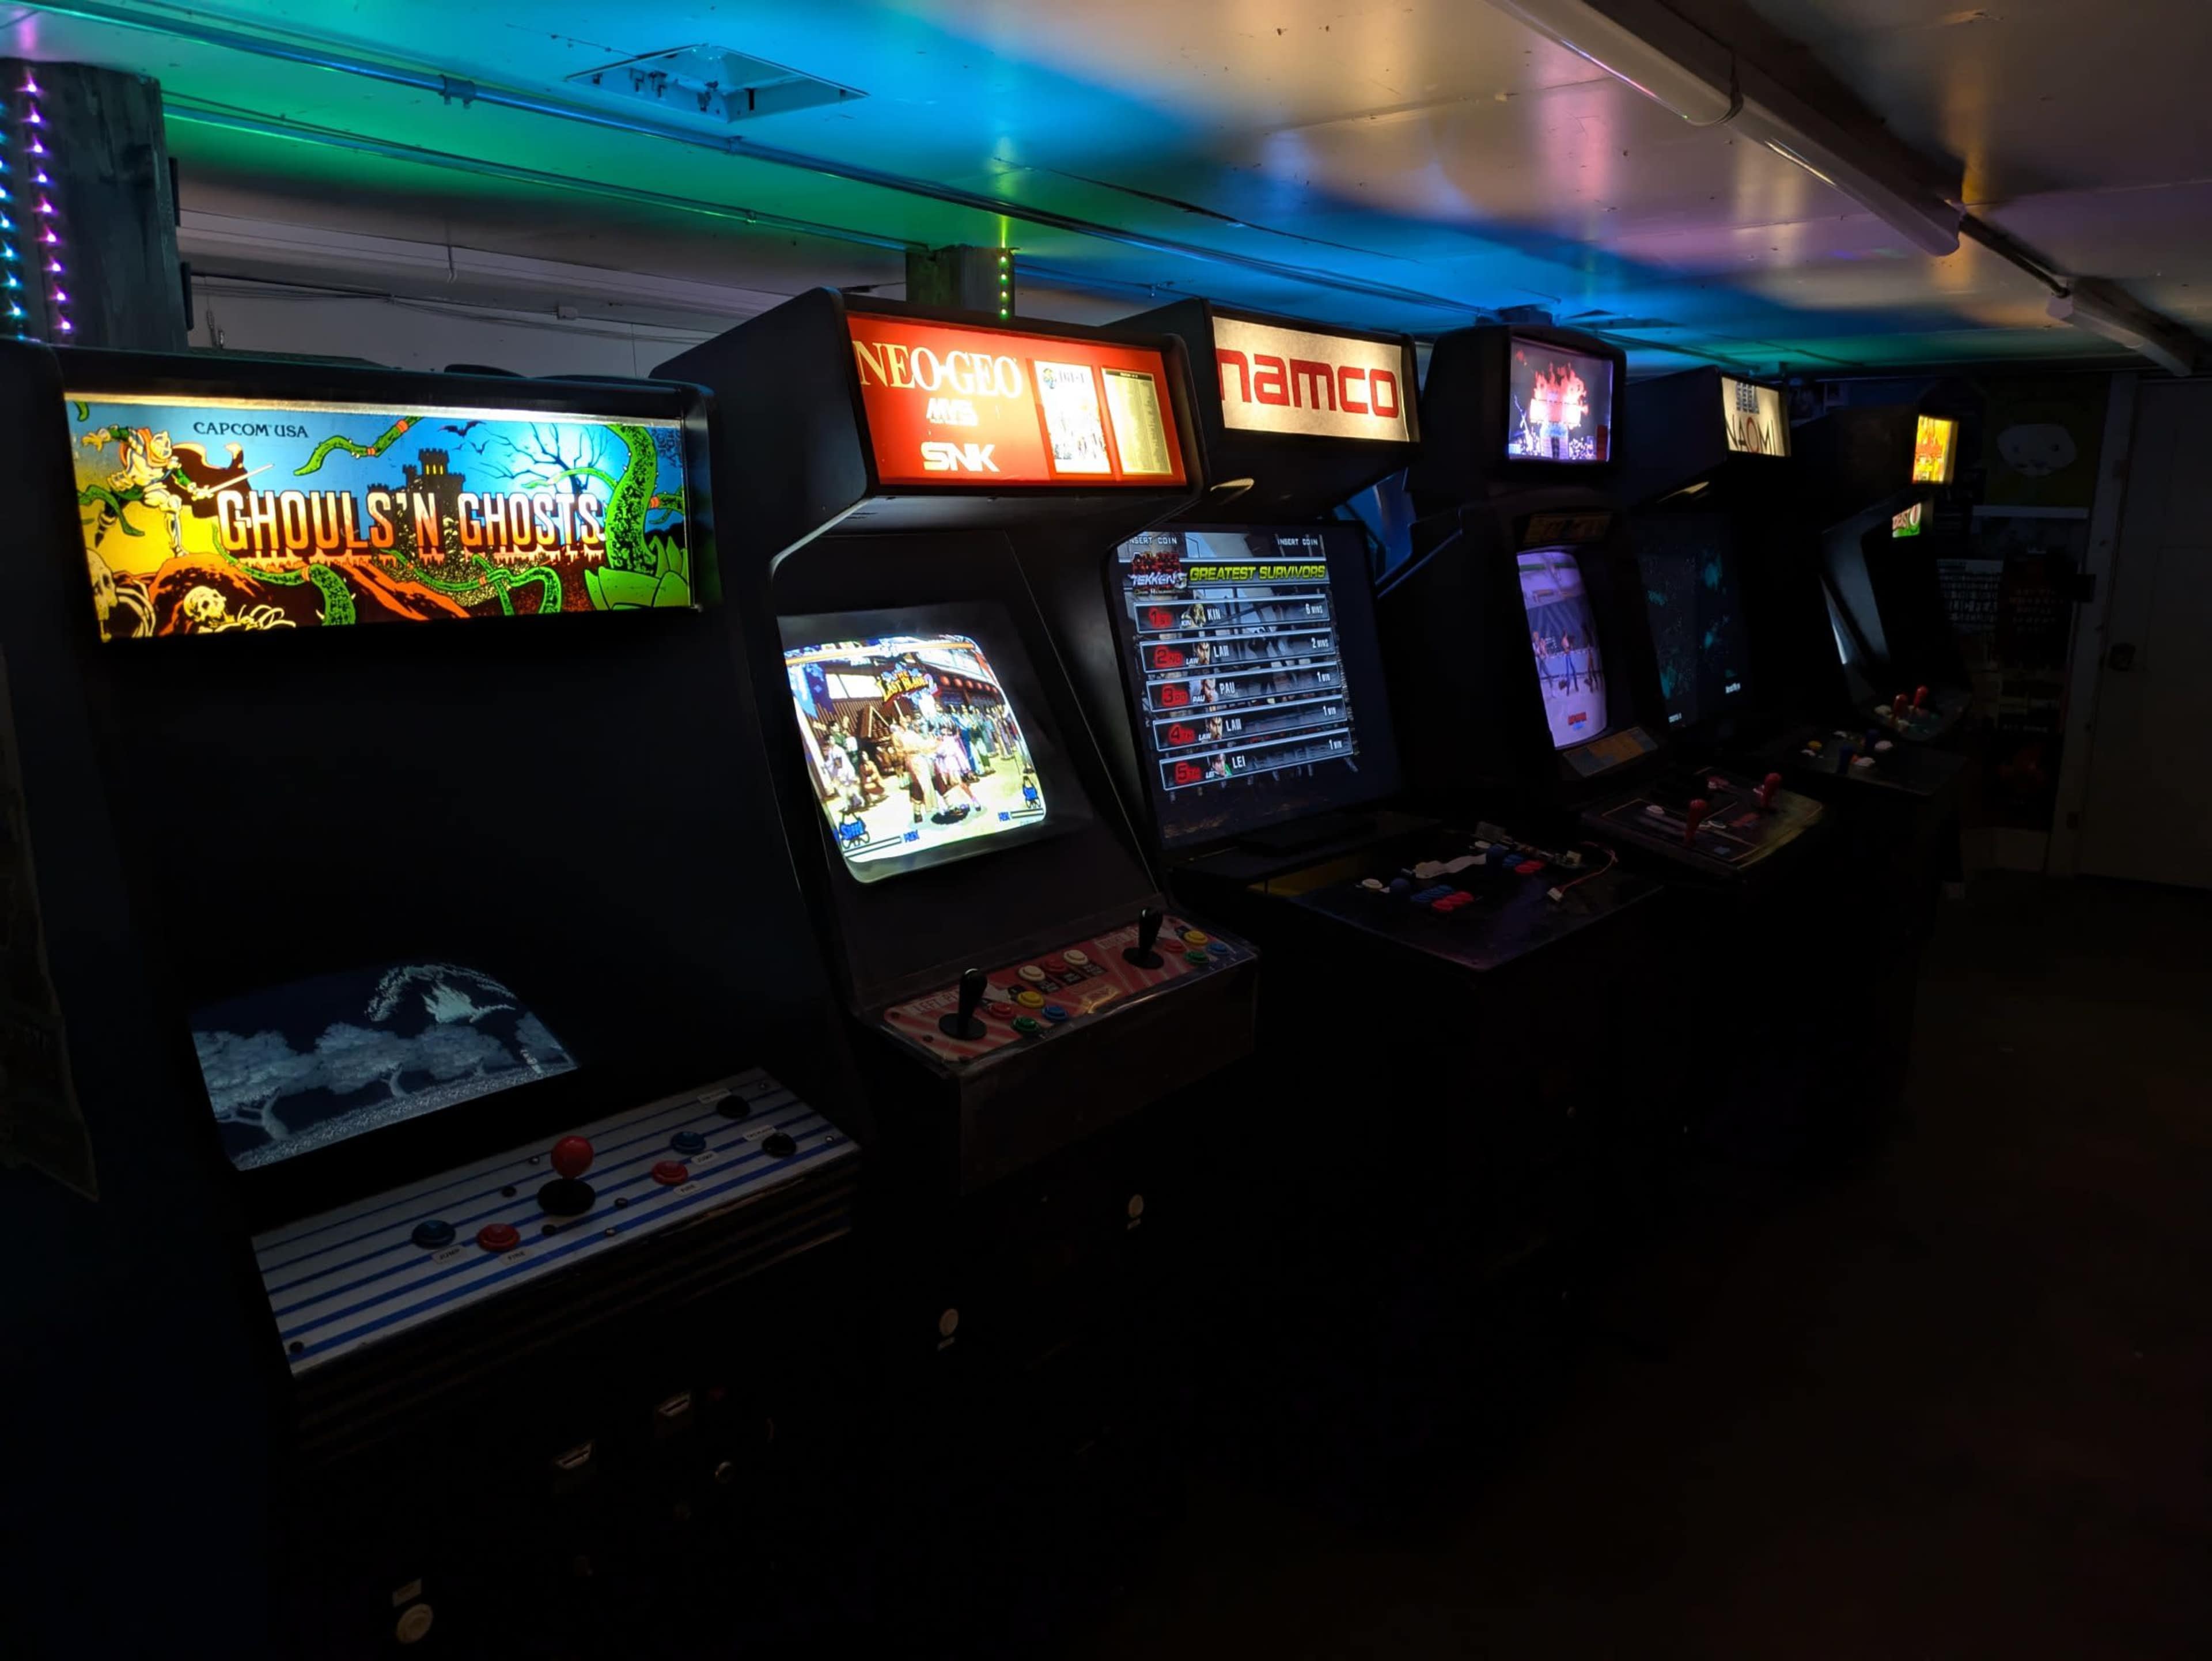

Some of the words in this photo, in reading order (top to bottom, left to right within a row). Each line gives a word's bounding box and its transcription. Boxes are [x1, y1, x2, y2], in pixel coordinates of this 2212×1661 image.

[1215, 347, 1399, 419] namco
[274, 425, 309, 438] USA
[1726, 414, 1777, 456] NAOMI
[921, 441, 1000, 472] SNK
[457, 491, 606, 552] GHOSTS
[1157, 536, 1177, 544] COIN
[1302, 538, 1318, 546] COIN
[1190, 566, 1256, 581] GREATEST
[1259, 565, 1326, 580] SURVIVORS
[1207, 608, 1221, 620] KIN
[876, 679, 903, 702] LAST
[1219, 682, 1236, 695] PAU
[1232, 755, 1247, 769] LEI
